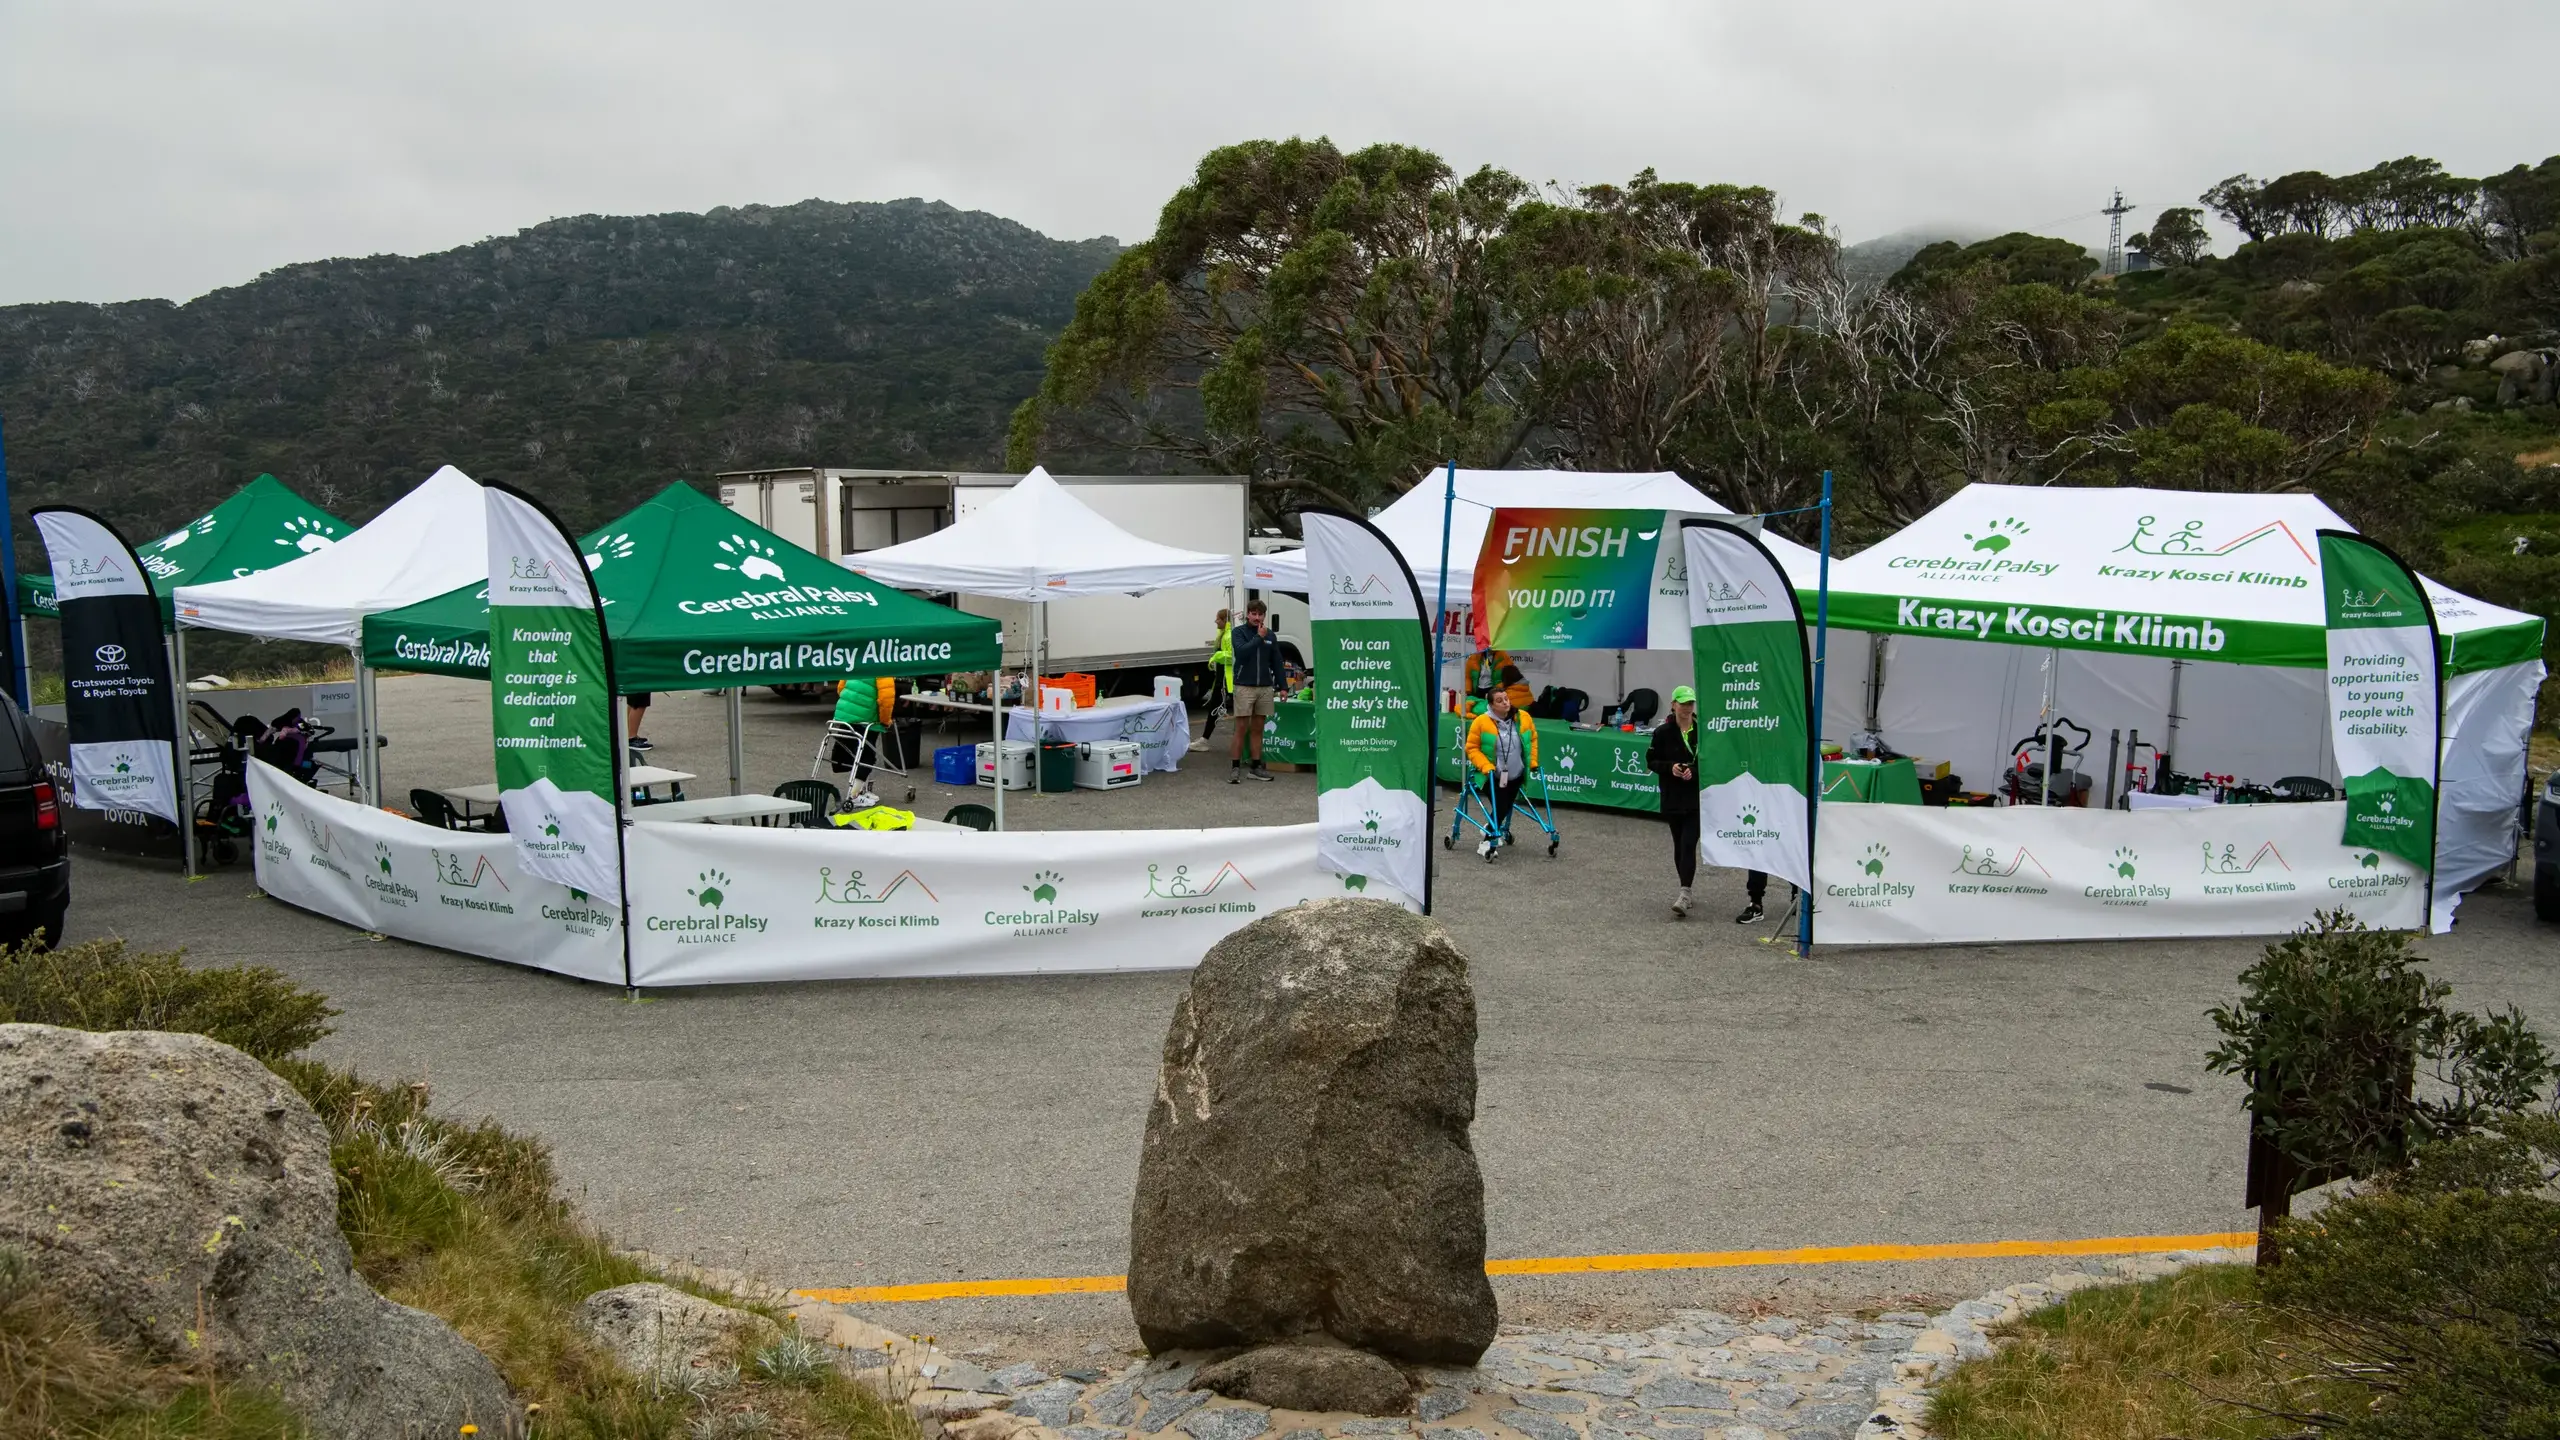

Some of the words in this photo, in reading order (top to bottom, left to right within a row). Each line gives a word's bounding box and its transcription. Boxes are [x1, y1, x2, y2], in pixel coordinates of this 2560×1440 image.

[1504, 527, 1629, 558] FINISH
[1888, 556, 1992, 573] Cerebral
[1992, 559, 2060, 576] Palsy
[1917, 572, 2003, 582] ALLIANCE
[2098, 564, 2165, 582] Krazy
[2168, 567, 2235, 584] Kosci
[2237, 572, 2308, 589] Klimb
[1508, 589, 1546, 608] YOU
[1550, 589, 1585, 608] DID
[1589, 589, 1616, 608] IT!
[1659, 588, 1684, 597] Krazy
[33, 589, 59, 611] Cereb
[678, 585, 804, 616] Cerebral
[801, 586, 880, 607] Palsy
[751, 605, 848, 621] ALLIANCE
[1898, 598, 1999, 639] Krazy
[2005, 607, 2104, 642] Kosci
[2113, 615, 2225, 652] Klimb
[512, 628, 572, 645] Knowing
[395, 634, 459, 665] Cerebral
[459, 642, 490, 668] Pals
[1340, 638, 1363, 650] You
[1367, 640, 1390, 650] can
[528, 650, 558, 663] that
[683, 644, 791, 675] Cerebral
[797, 643, 856, 672] Palsy
[862, 638, 952, 665] Alliance
[1341, 657, 1391, 670] achieve
[2343, 655, 2405, 667] Providing
[1722, 661, 1759, 674] Great
[72, 677, 125, 688] Chatswood
[127, 677, 155, 688] Toyota
[505, 672, 562, 687] courage
[566, 671, 577, 684] is
[1332, 677, 1401, 693] anything...
[1722, 679, 1760, 692] minds
[2331, 673, 2419, 686] opportunities
[83, 690, 91, 698] &
[93, 689, 116, 699] Ryde
[118, 688, 147, 696] Toyota
[321, 693, 350, 701] PHYSIO
[503, 692, 577, 706] dedication
[2348, 691, 2360, 701] to
[2363, 690, 2404, 703] young
[1326, 697, 1348, 709] the
[1351, 697, 1384, 712] sky's
[1387, 697, 1408, 709] the
[1726, 697, 1759, 711] think
[530, 714, 555, 727] and
[2339, 707, 2382, 721] people
[2386, 706, 2414, 717] with
[1351, 716, 1386, 729] limit!
[1707, 716, 1779, 732] differently!
[2347, 723, 2408, 737] disability.
[496, 735, 586, 749] commitment.
[1274, 737, 1296, 749] Palsy
[1340, 738, 1368, 746] Hannah
[1370, 738, 1397, 748] Diviney
[58, 762, 73, 784] Toy
[90, 775, 130, 786] Cerebral
[131, 775, 155, 783] Palsy
[1574, 774, 1597, 787] Palsy
[1611, 780, 1633, 791] Krazy
[1635, 783, 1655, 792] Kosci
[1546, 784, 1581, 793] ALLIANCE
[60, 787, 74, 808] Toy
[104, 809, 148, 826] TOYOTA
[2356, 813, 2389, 824] Cerebral
[2390, 816, 2414, 828] Palsy
[1337, 834, 1376, 844] Cerebral
[1379, 836, 1401, 848] Palsy
[1717, 829, 1755, 839] Cerebral
[1757, 830, 1780, 840] Palsy
[275, 841, 292, 860] Palsy
[562, 841, 586, 854] Palsy
[310, 854, 328, 869] Krazy
[2328, 874, 2379, 889] Cerebral
[2382, 873, 2411, 887] Palsy
[365, 875, 395, 895] Cerebral
[395, 881, 418, 902] Palsy
[1827, 883, 1880, 897] Cerebral
[1883, 882, 1915, 898] Palsy
[1949, 884, 1980, 895] Krazy
[1982, 884, 2013, 894] Kosci
[2015, 885, 2048, 895] Klimb
[2084, 885, 2137, 898] Cerebral
[2140, 884, 2171, 899] Palsy
[2204, 884, 2233, 895] Krazy
[2236, 884, 2264, 893] Kosci
[2266, 882, 2296, 892] Klimb
[2348, 889, 2388, 898] ALLIANCE
[380, 895, 407, 907] ALLIANCE
[440, 895, 463, 910] Krazy
[465, 898, 488, 911] Kosci
[489, 901, 514, 914] Klimb
[1848, 899, 1892, 908] ALLIANCE
[1141, 906, 1178, 919] Krazy
[1181, 903, 1217, 915] Kosci
[1219, 902, 1256, 914] Klimb
[541, 905, 589, 923] Cerebral
[591, 909, 614, 931] Palsy
[646, 915, 720, 931] Cerebral
[724, 914, 768, 932] Palsy
[814, 916, 855, 930] Krazy
[858, 916, 897, 928] Kosci
[900, 916, 939, 927] Klimb
[984, 909, 1055, 927] Cerebral
[1057, 910, 1099, 927] Palsy
[566, 924, 595, 937] ALLIANCE
[1013, 927, 1069, 938] ALLIANCE
[677, 934, 736, 944] ALLIANCE
